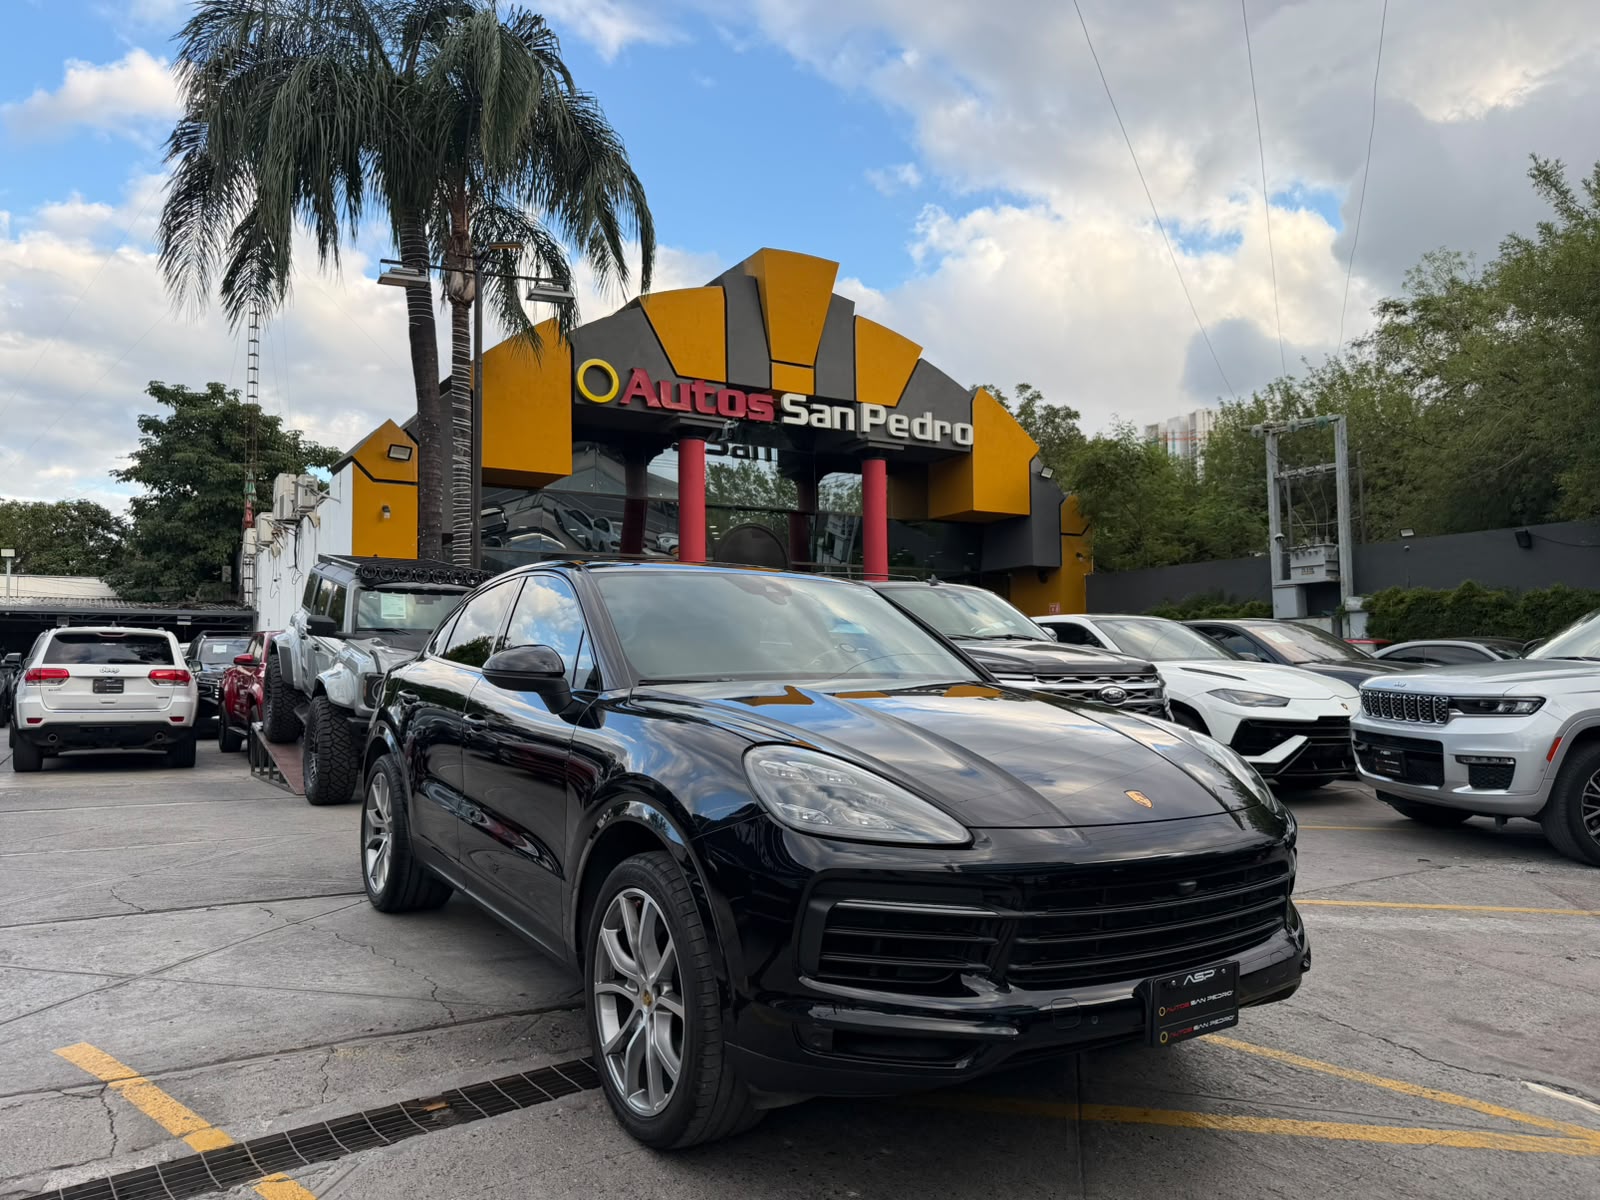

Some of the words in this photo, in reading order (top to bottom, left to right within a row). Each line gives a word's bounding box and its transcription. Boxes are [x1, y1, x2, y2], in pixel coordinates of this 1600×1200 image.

[619, 368, 775, 422] Autos
[781, 393, 856, 431] San
[860, 403, 974, 446] Pedro
[1183, 969, 1215, 986] ASP
[1190, 997, 1207, 1006] SAN
